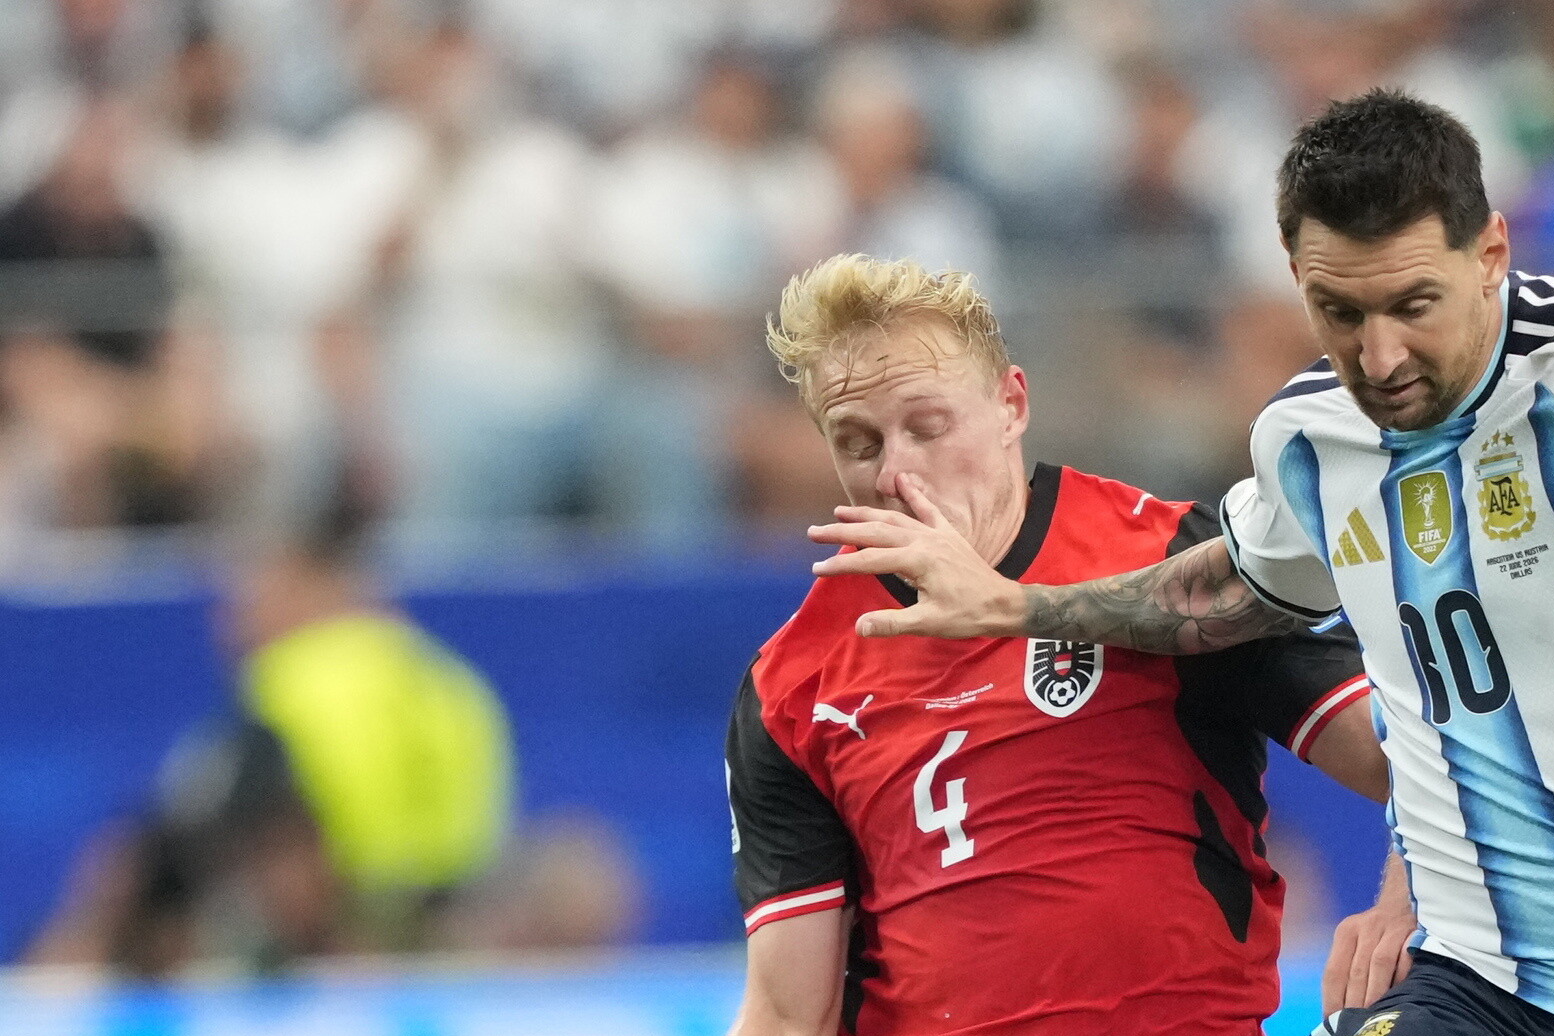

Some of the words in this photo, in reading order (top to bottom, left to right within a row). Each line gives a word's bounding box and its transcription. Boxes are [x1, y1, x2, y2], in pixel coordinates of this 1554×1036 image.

[1489, 476, 1520, 516] AFA
[1418, 529, 1442, 543] FIFA
[1509, 567, 1534, 580] DALLAS
[1522, 556, 1540, 567] 2026
[1397, 589, 1513, 726] 10
[913, 730, 975, 869] 4
